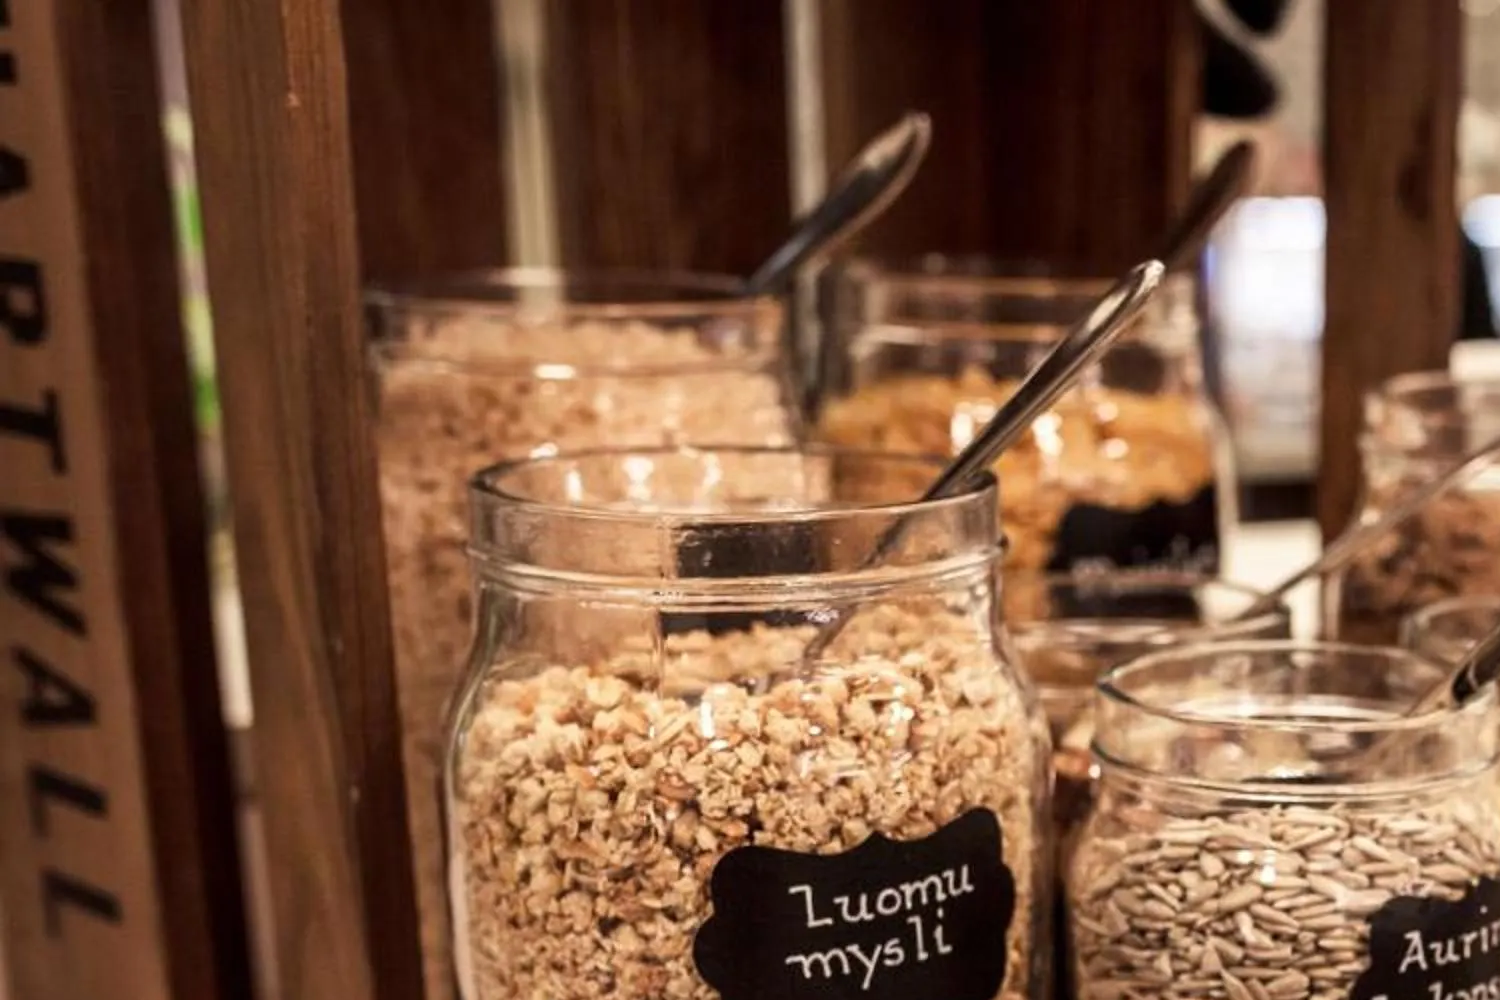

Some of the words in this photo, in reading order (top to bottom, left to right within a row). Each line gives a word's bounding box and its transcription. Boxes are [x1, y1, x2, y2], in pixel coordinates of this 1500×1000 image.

[0, 0, 124, 939] RTWALL
[787, 864, 975, 929] Luomu
[784, 907, 953, 991] mysli
